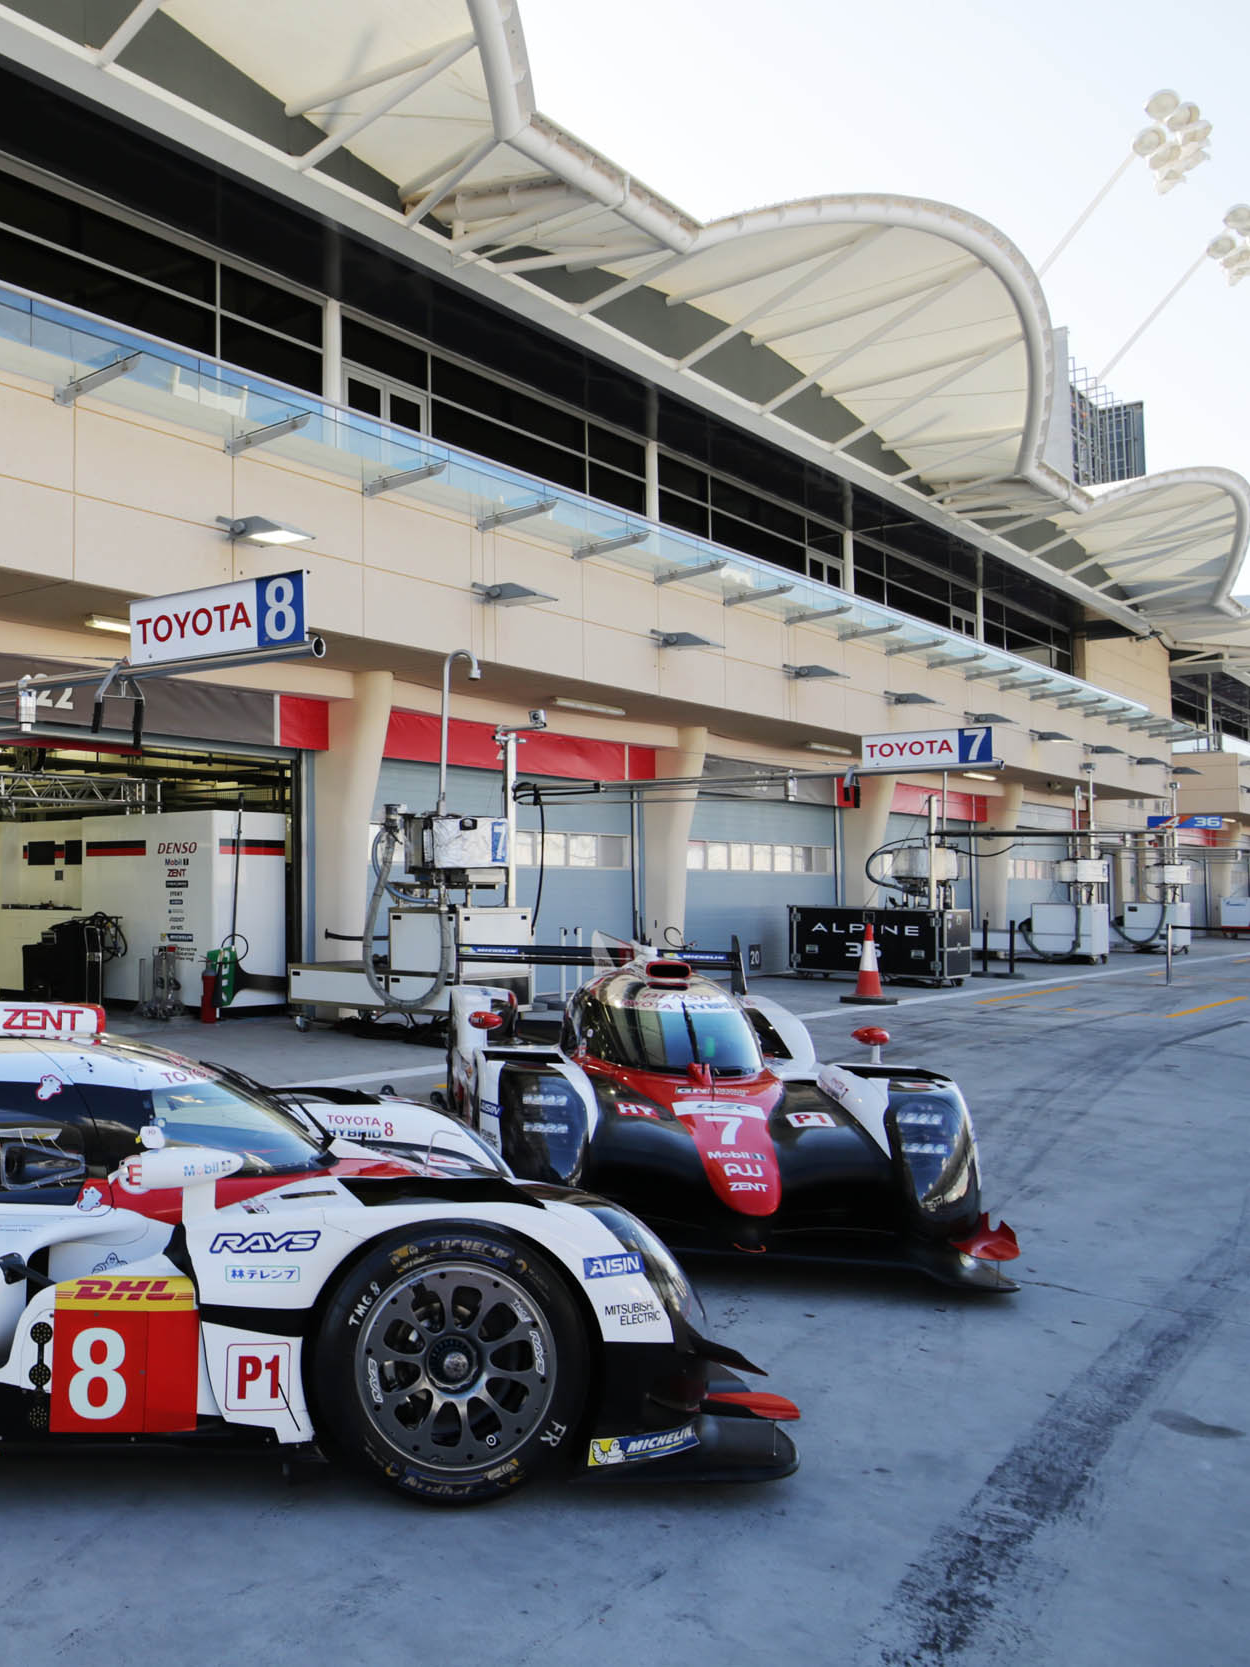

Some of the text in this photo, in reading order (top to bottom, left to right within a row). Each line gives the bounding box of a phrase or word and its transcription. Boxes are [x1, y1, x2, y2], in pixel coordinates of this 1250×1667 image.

[137, 577, 296, 645] TOYOTA 8
[865, 728, 987, 761] TOYOTA 7
[1193, 817, 1220, 827] 36
[158, 842, 197, 854] DENSO
[493, 822, 506, 860] 7
[167, 868, 186, 877] ZENT
[750, 951, 760, 965] 20
[3, 1009, 84, 1031] ZENT
[326, 1114, 394, 1137] TOYOTA 8
[704, 1116, 743, 1144] 7
[793, 1113, 829, 1124] P1
[707, 1151, 749, 1160] Mobil
[729, 1182, 769, 1192] ZENT
[209, 1230, 321, 1253] RAYS
[231, 1268, 296, 1280] 林テレンプ
[590, 1256, 640, 1274] AISIN
[74, 1279, 175, 1300] DHL
[349, 1281, 381, 1327] TMG 8
[620, 1310, 661, 1326] ELECTRIC
[529, 1330, 546, 1376] RAYS
[68, 1327, 127, 1420] 8
[237, 1354, 280, 1399] P1
[367, 1357, 384, 1404] RAYS
[539, 1420, 567, 1448] FR
[626, 1425, 694, 1453] MICHELIN
